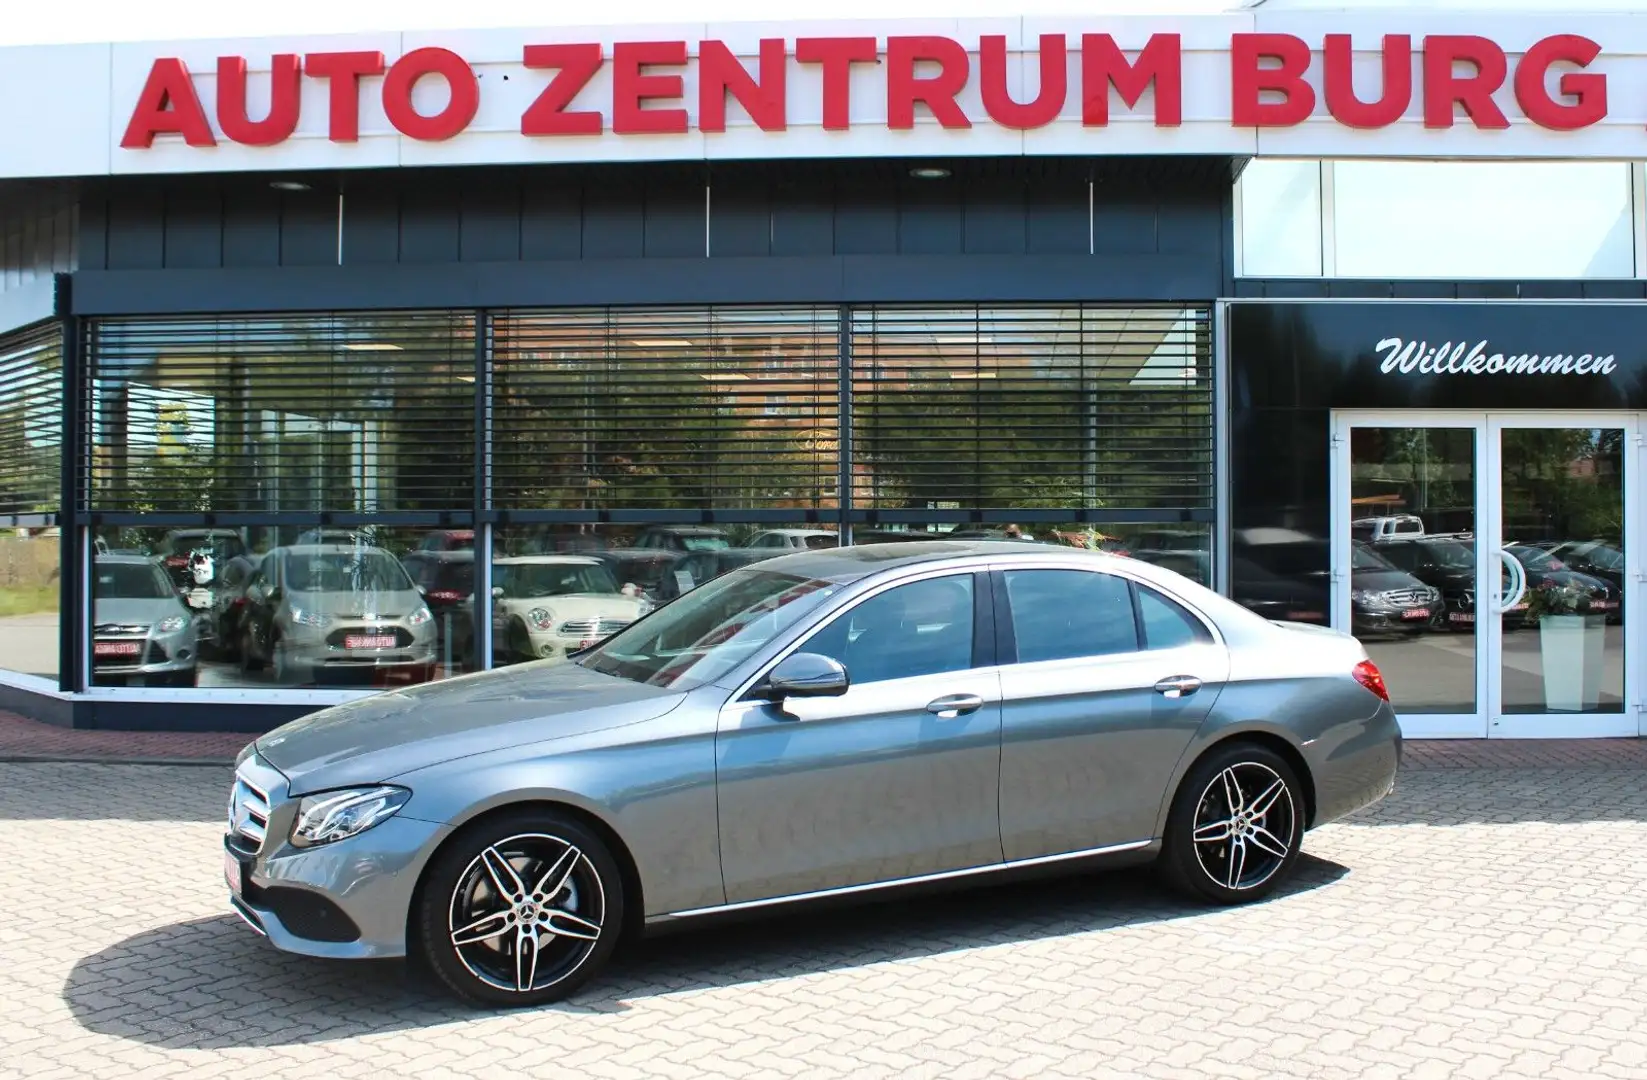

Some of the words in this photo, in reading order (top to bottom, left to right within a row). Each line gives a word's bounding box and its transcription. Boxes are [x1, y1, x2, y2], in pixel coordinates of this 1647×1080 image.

[121, 46, 479, 149] AUTO
[521, 33, 1182, 136] ZENTRUM
[1230, 33, 1607, 131] BURG
[1375, 337, 1616, 375] Willkommen
